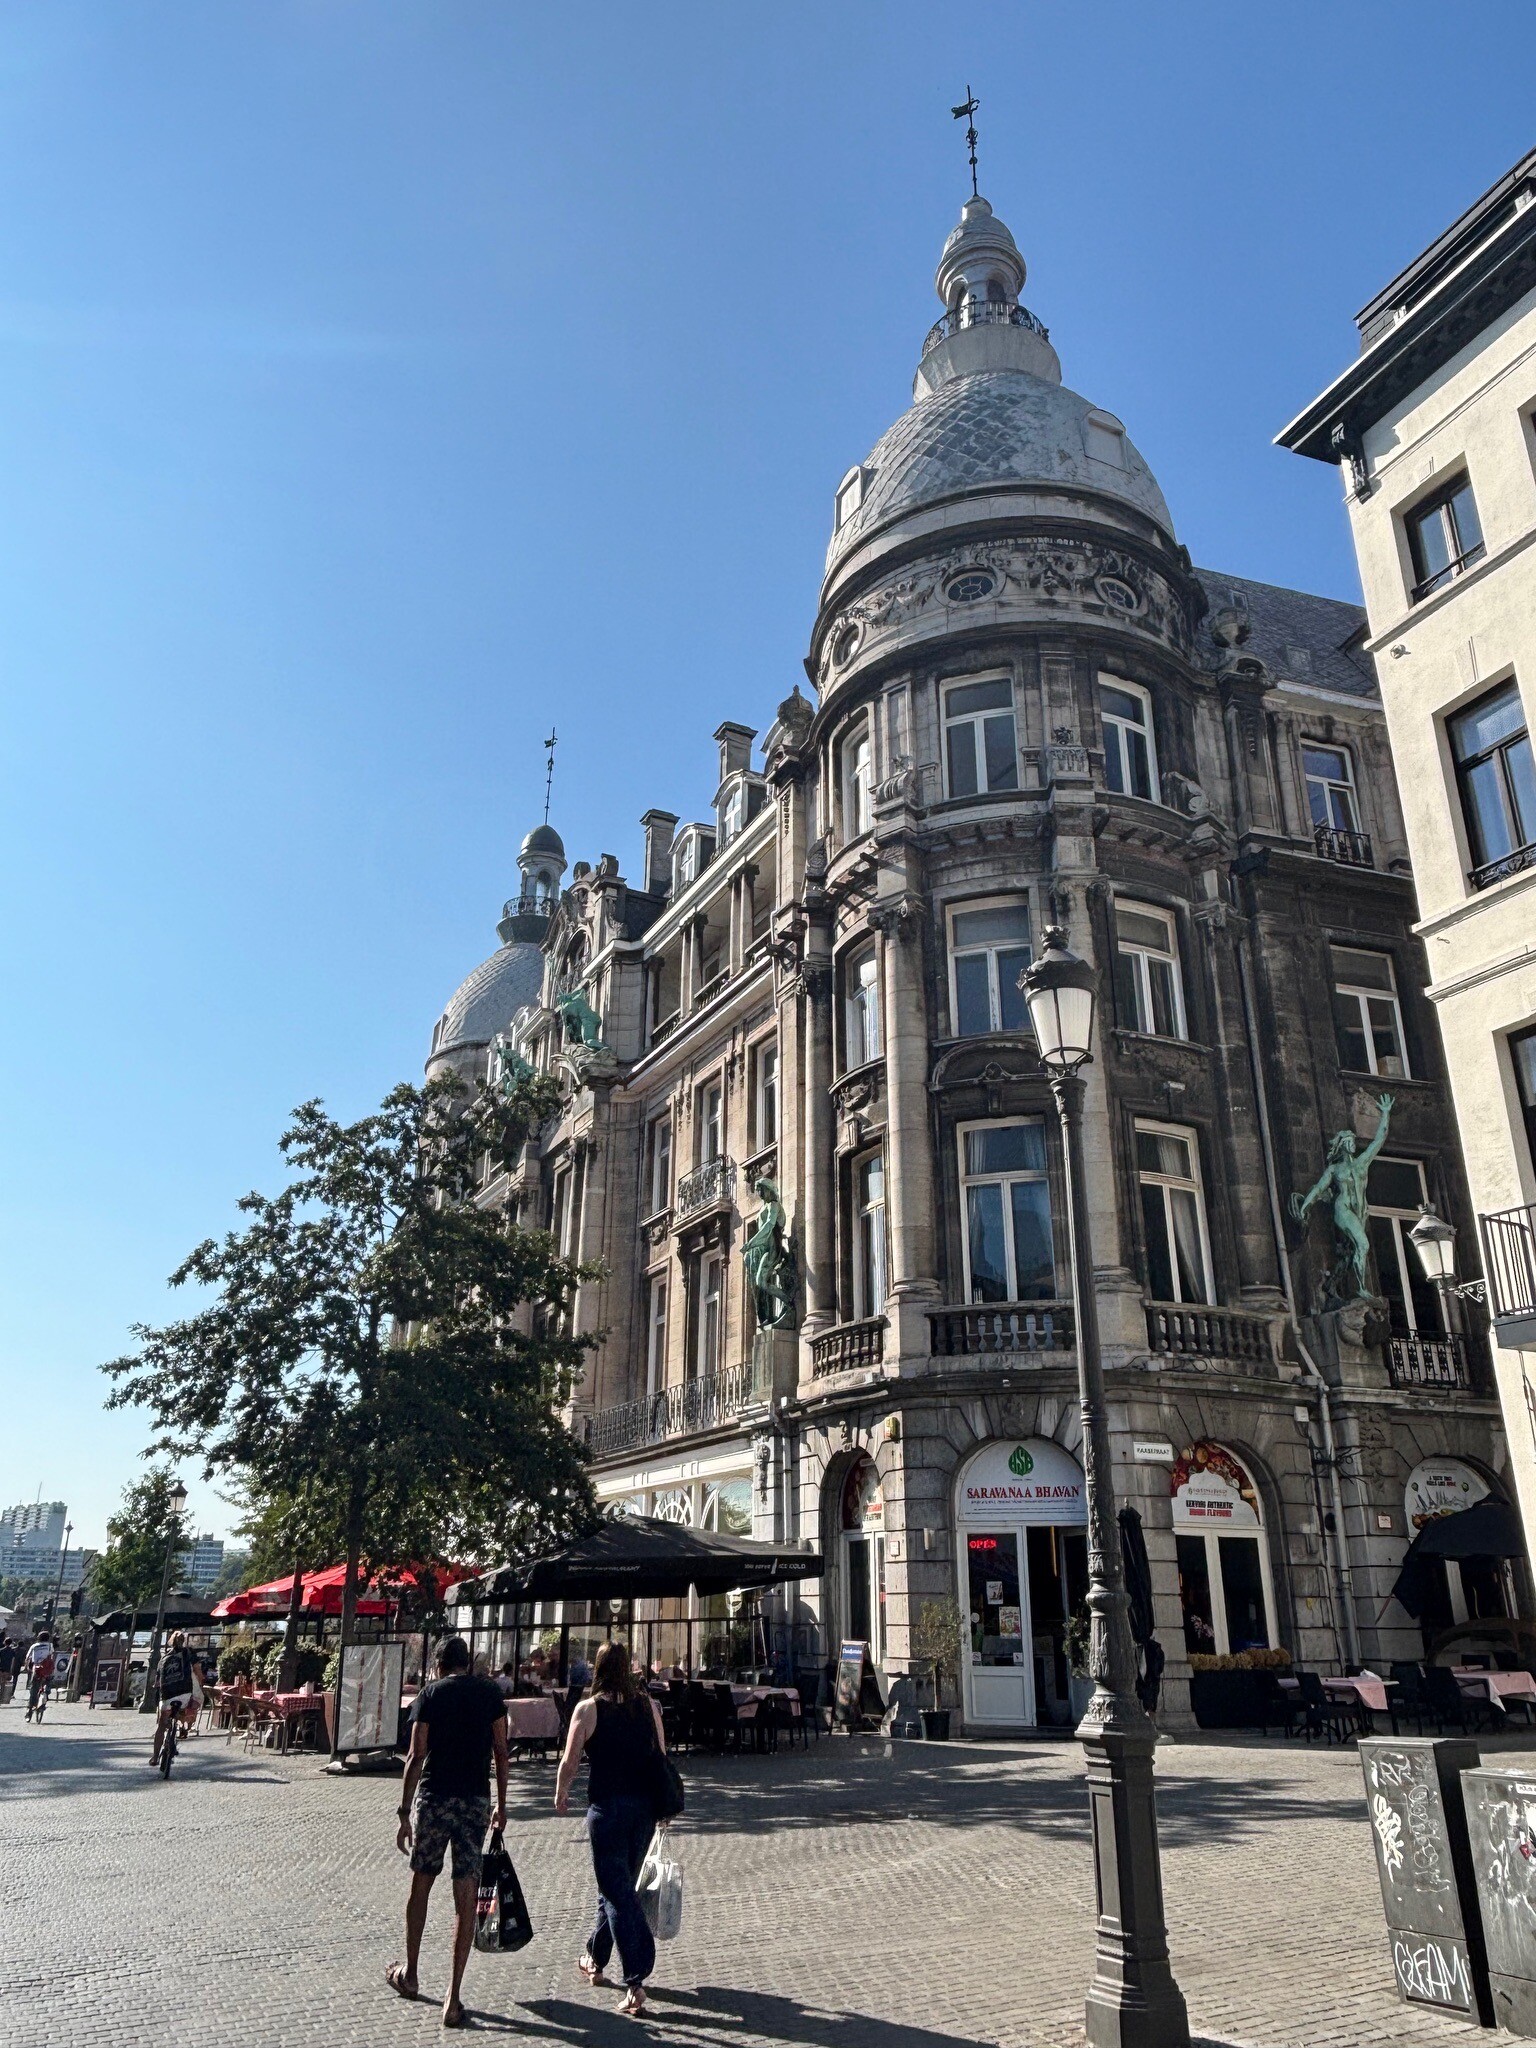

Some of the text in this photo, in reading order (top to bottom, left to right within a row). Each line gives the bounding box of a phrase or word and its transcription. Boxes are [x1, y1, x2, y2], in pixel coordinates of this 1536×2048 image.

[967, 1485, 1080, 1498] SARAVANAA BHAVAN
[969, 1539, 997, 1549] OPEN
